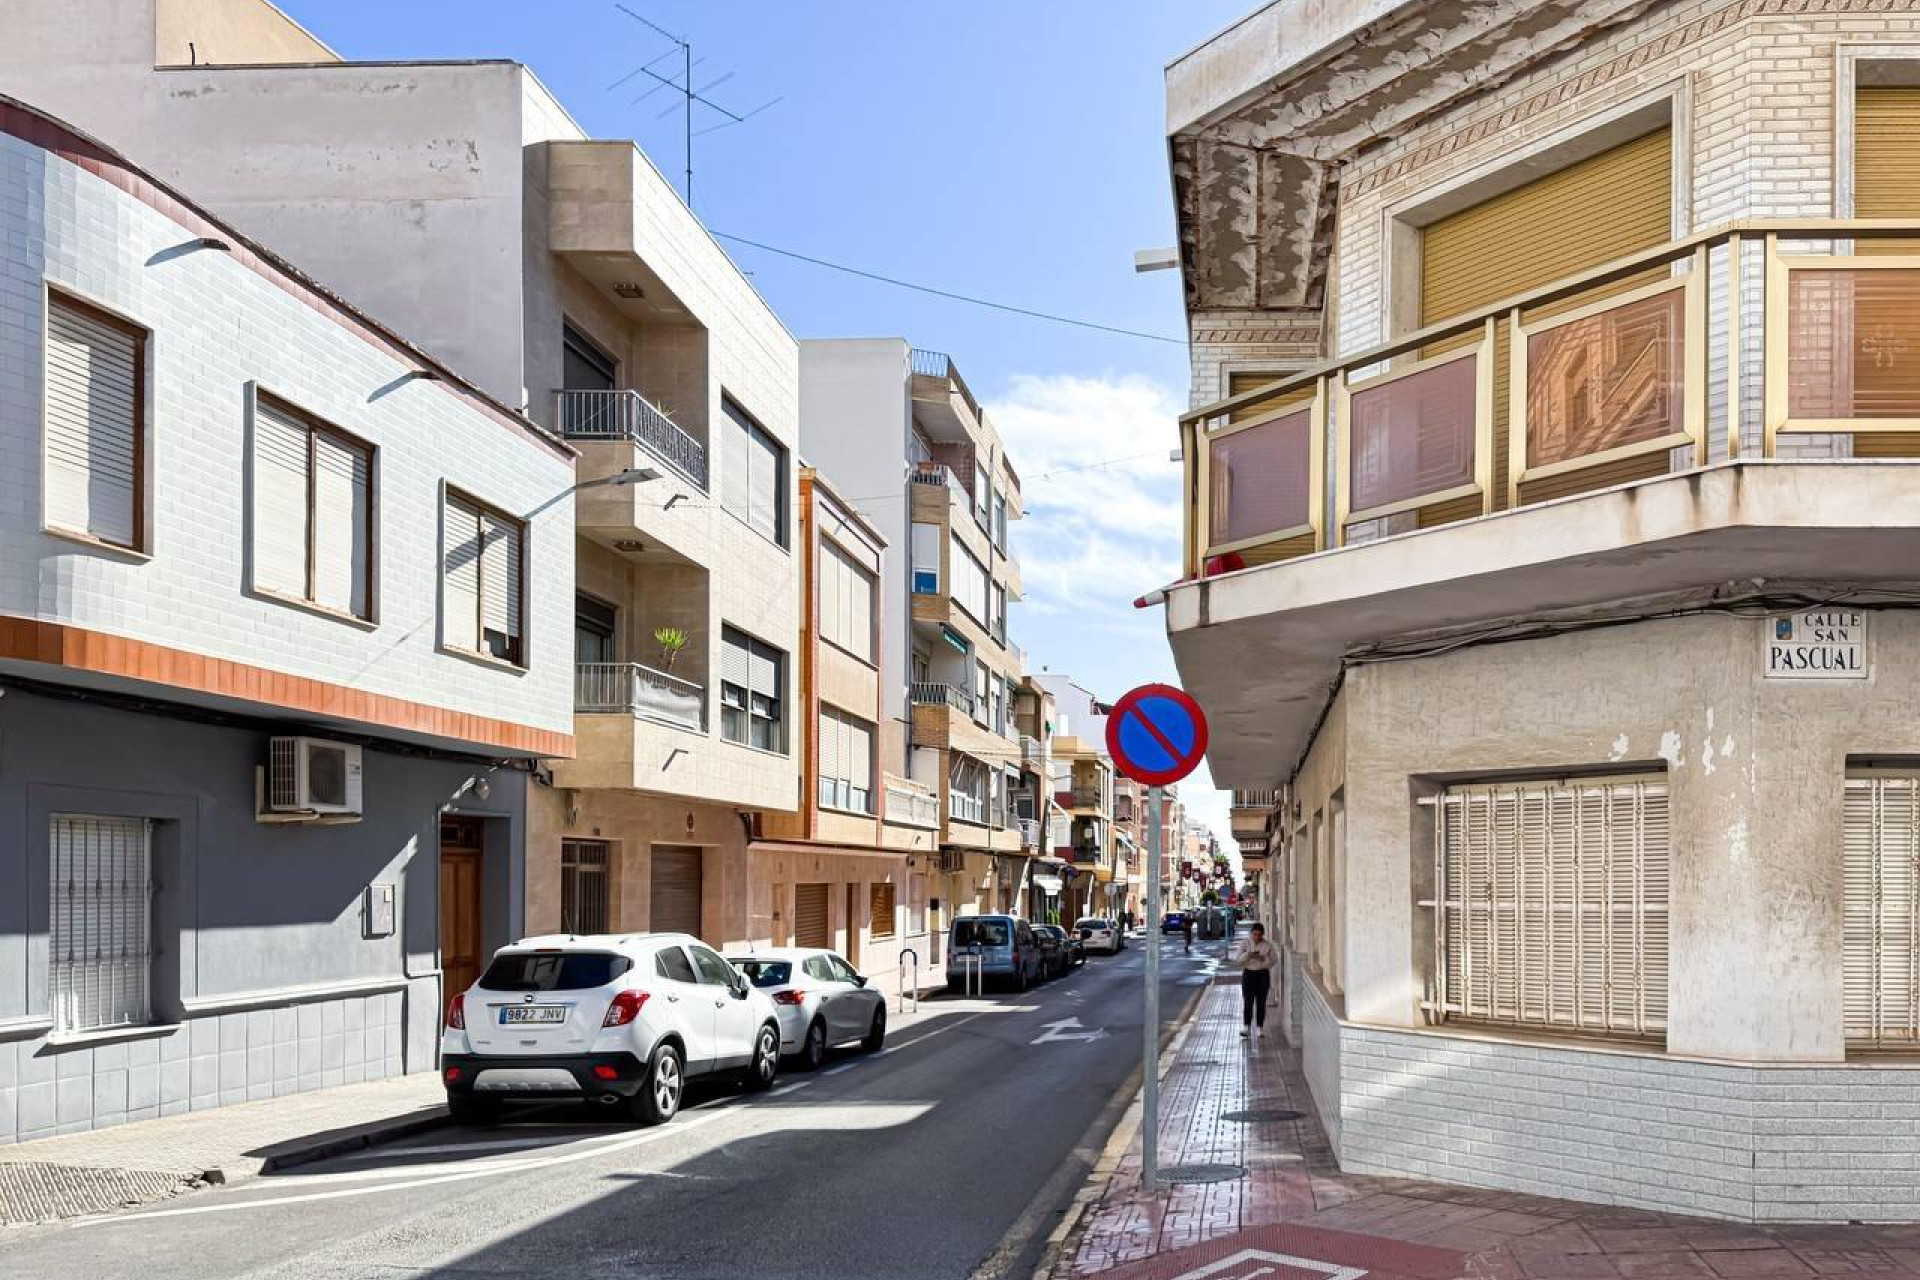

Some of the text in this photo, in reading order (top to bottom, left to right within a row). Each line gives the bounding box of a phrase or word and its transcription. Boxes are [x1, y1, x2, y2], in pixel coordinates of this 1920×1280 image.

[1804, 613, 1861, 627] CALLE
[1814, 629, 1849, 642] SAN
[1771, 647, 1861, 670] PASCUAL
[508, 1008, 562, 1020] 9822 JNV
